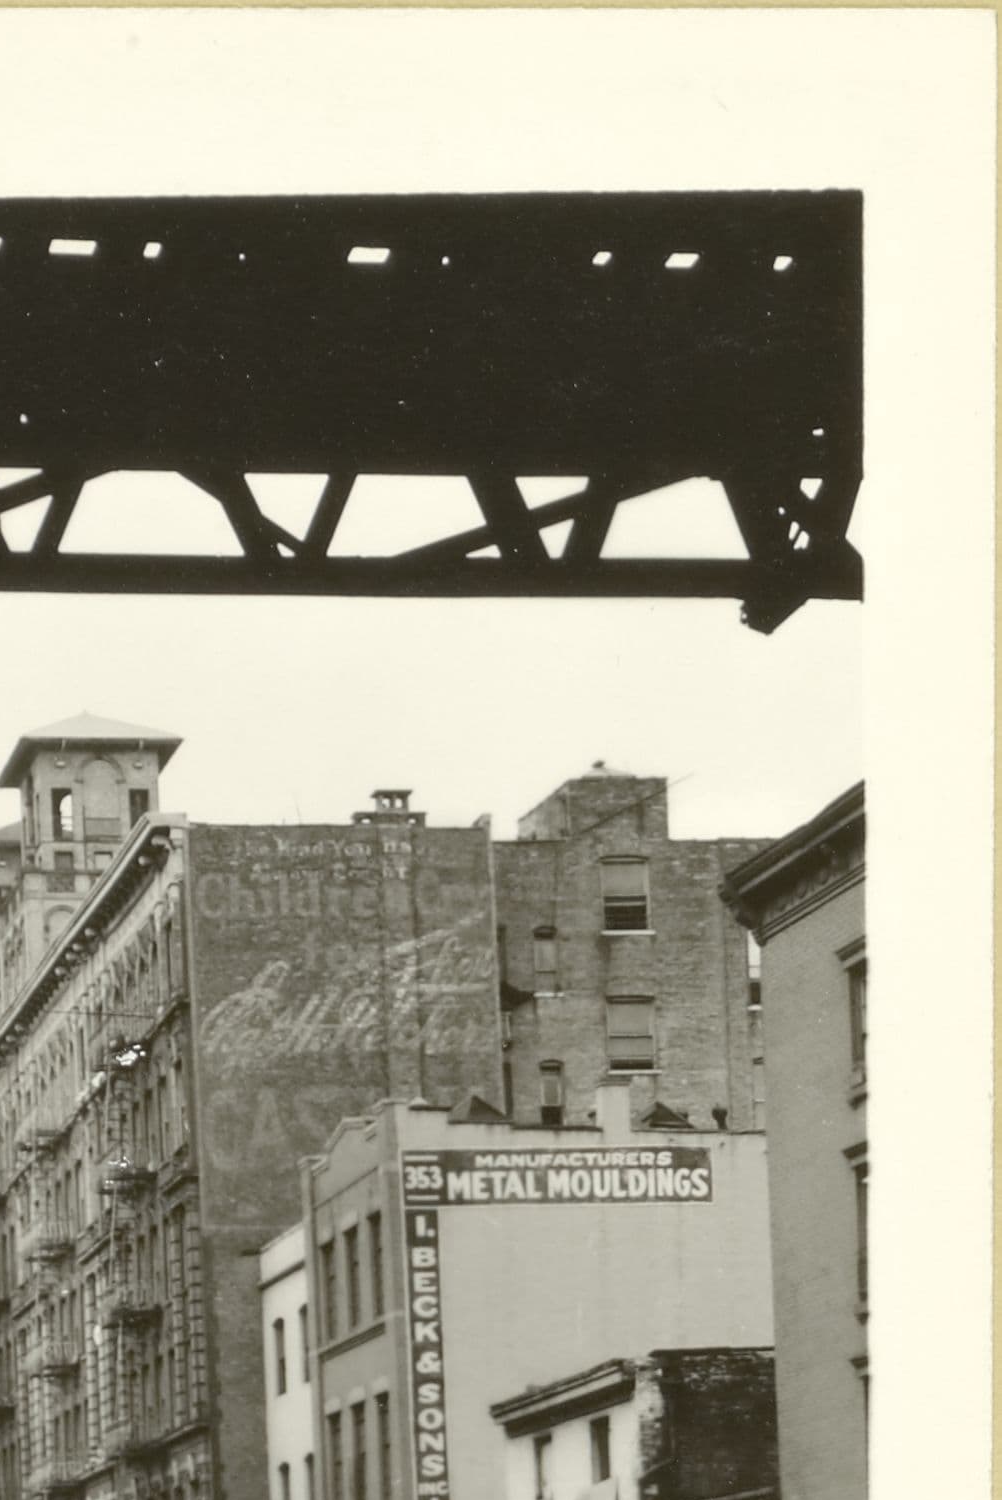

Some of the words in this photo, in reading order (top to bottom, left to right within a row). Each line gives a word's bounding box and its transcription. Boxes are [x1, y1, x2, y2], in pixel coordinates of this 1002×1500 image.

[474, 1150, 674, 1169] MANUFACTURERS
[404, 1165, 444, 1190] 353
[448, 1169, 543, 1201] METAL
[547, 1167, 710, 1200] MOULDINGS
[411, 1246, 440, 1344] BECK
[415, 1351, 443, 1375] &
[417, 1382, 447, 1478] SONS
